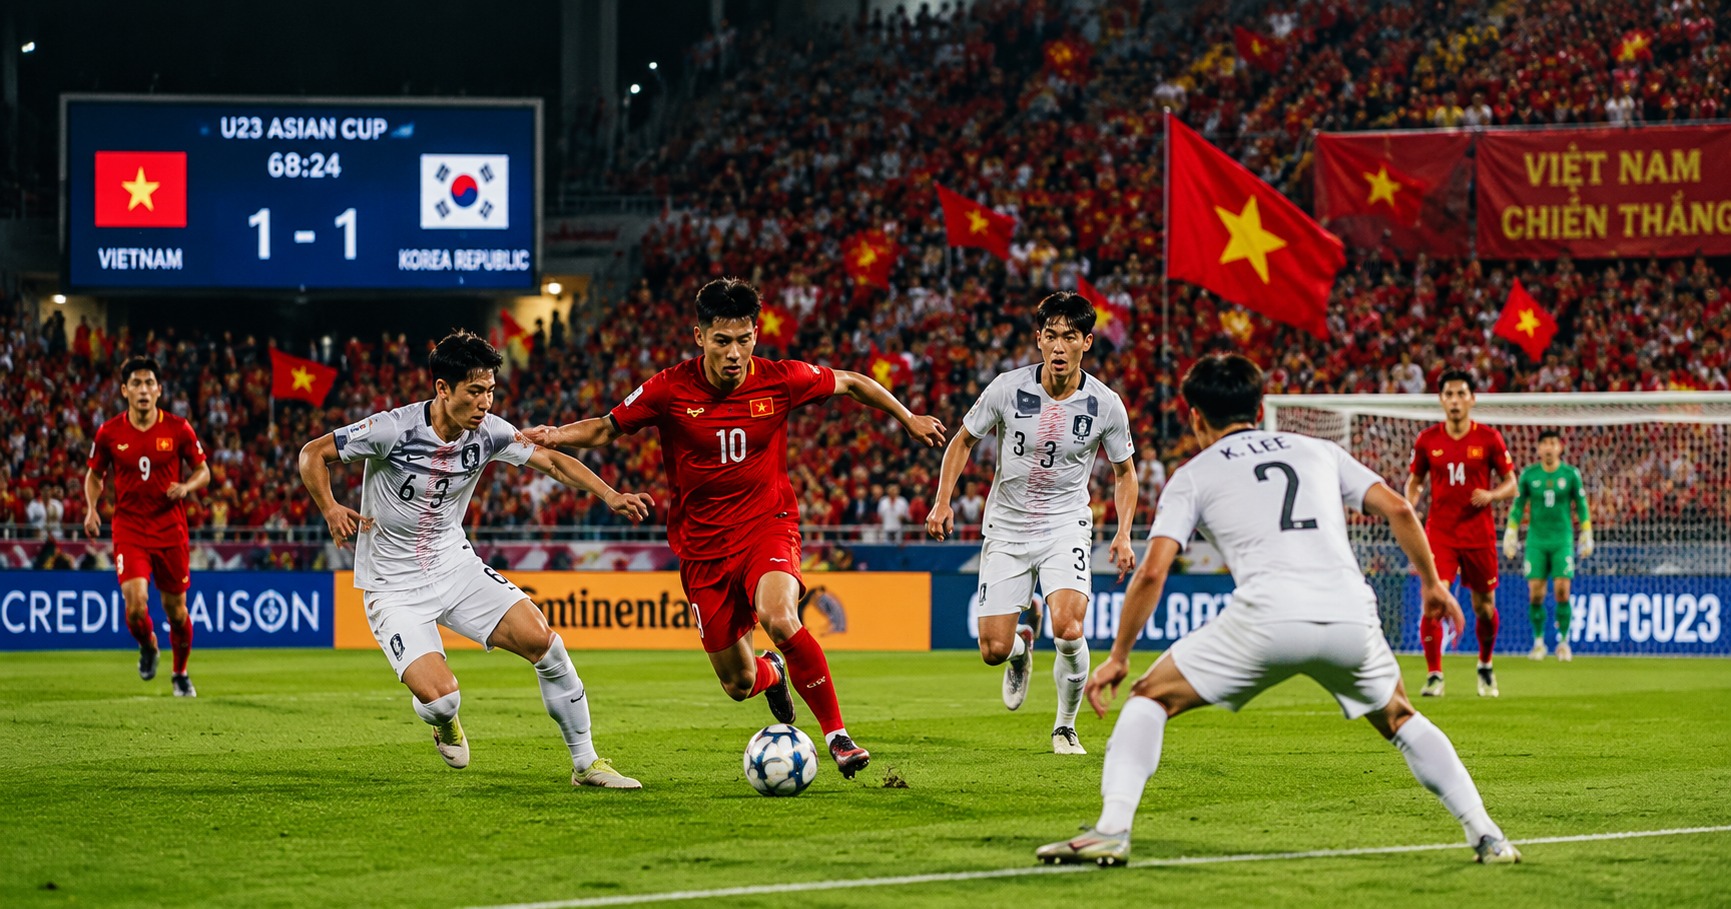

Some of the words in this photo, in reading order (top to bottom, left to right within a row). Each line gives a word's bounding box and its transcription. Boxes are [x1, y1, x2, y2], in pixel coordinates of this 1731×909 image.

[220, 116, 263, 139] U23
[267, 117, 336, 139] ASIAN
[340, 117, 388, 140] CUP
[267, 152, 341, 178] 68:24
[1619, 148, 1701, 185] NAM
[248, 207, 271, 260] 1
[334, 207, 357, 260] 1
[98, 247, 183, 270] VIETNAM
[398, 248, 452, 271] KOREA
[454, 248, 530, 271] REPUBLIC
[715, 428, 746, 464] 10
[1014, 431, 1026, 457] 3
[1040, 441, 1057, 468] 3
[1220, 446, 1246, 460] K.
[1247, 436, 1292, 455] LEE
[138, 456, 151, 482] 9
[1447, 461, 1466, 487] 14
[400, 474, 416, 501] 6
[430, 478, 449, 509] 3
[1254, 461, 1319, 532] 2
[1072, 547, 1086, 572] 3
[484, 567, 508, 585] 6
[2, 590, 125, 633] CREDI
[162, 589, 319, 633] AISON
